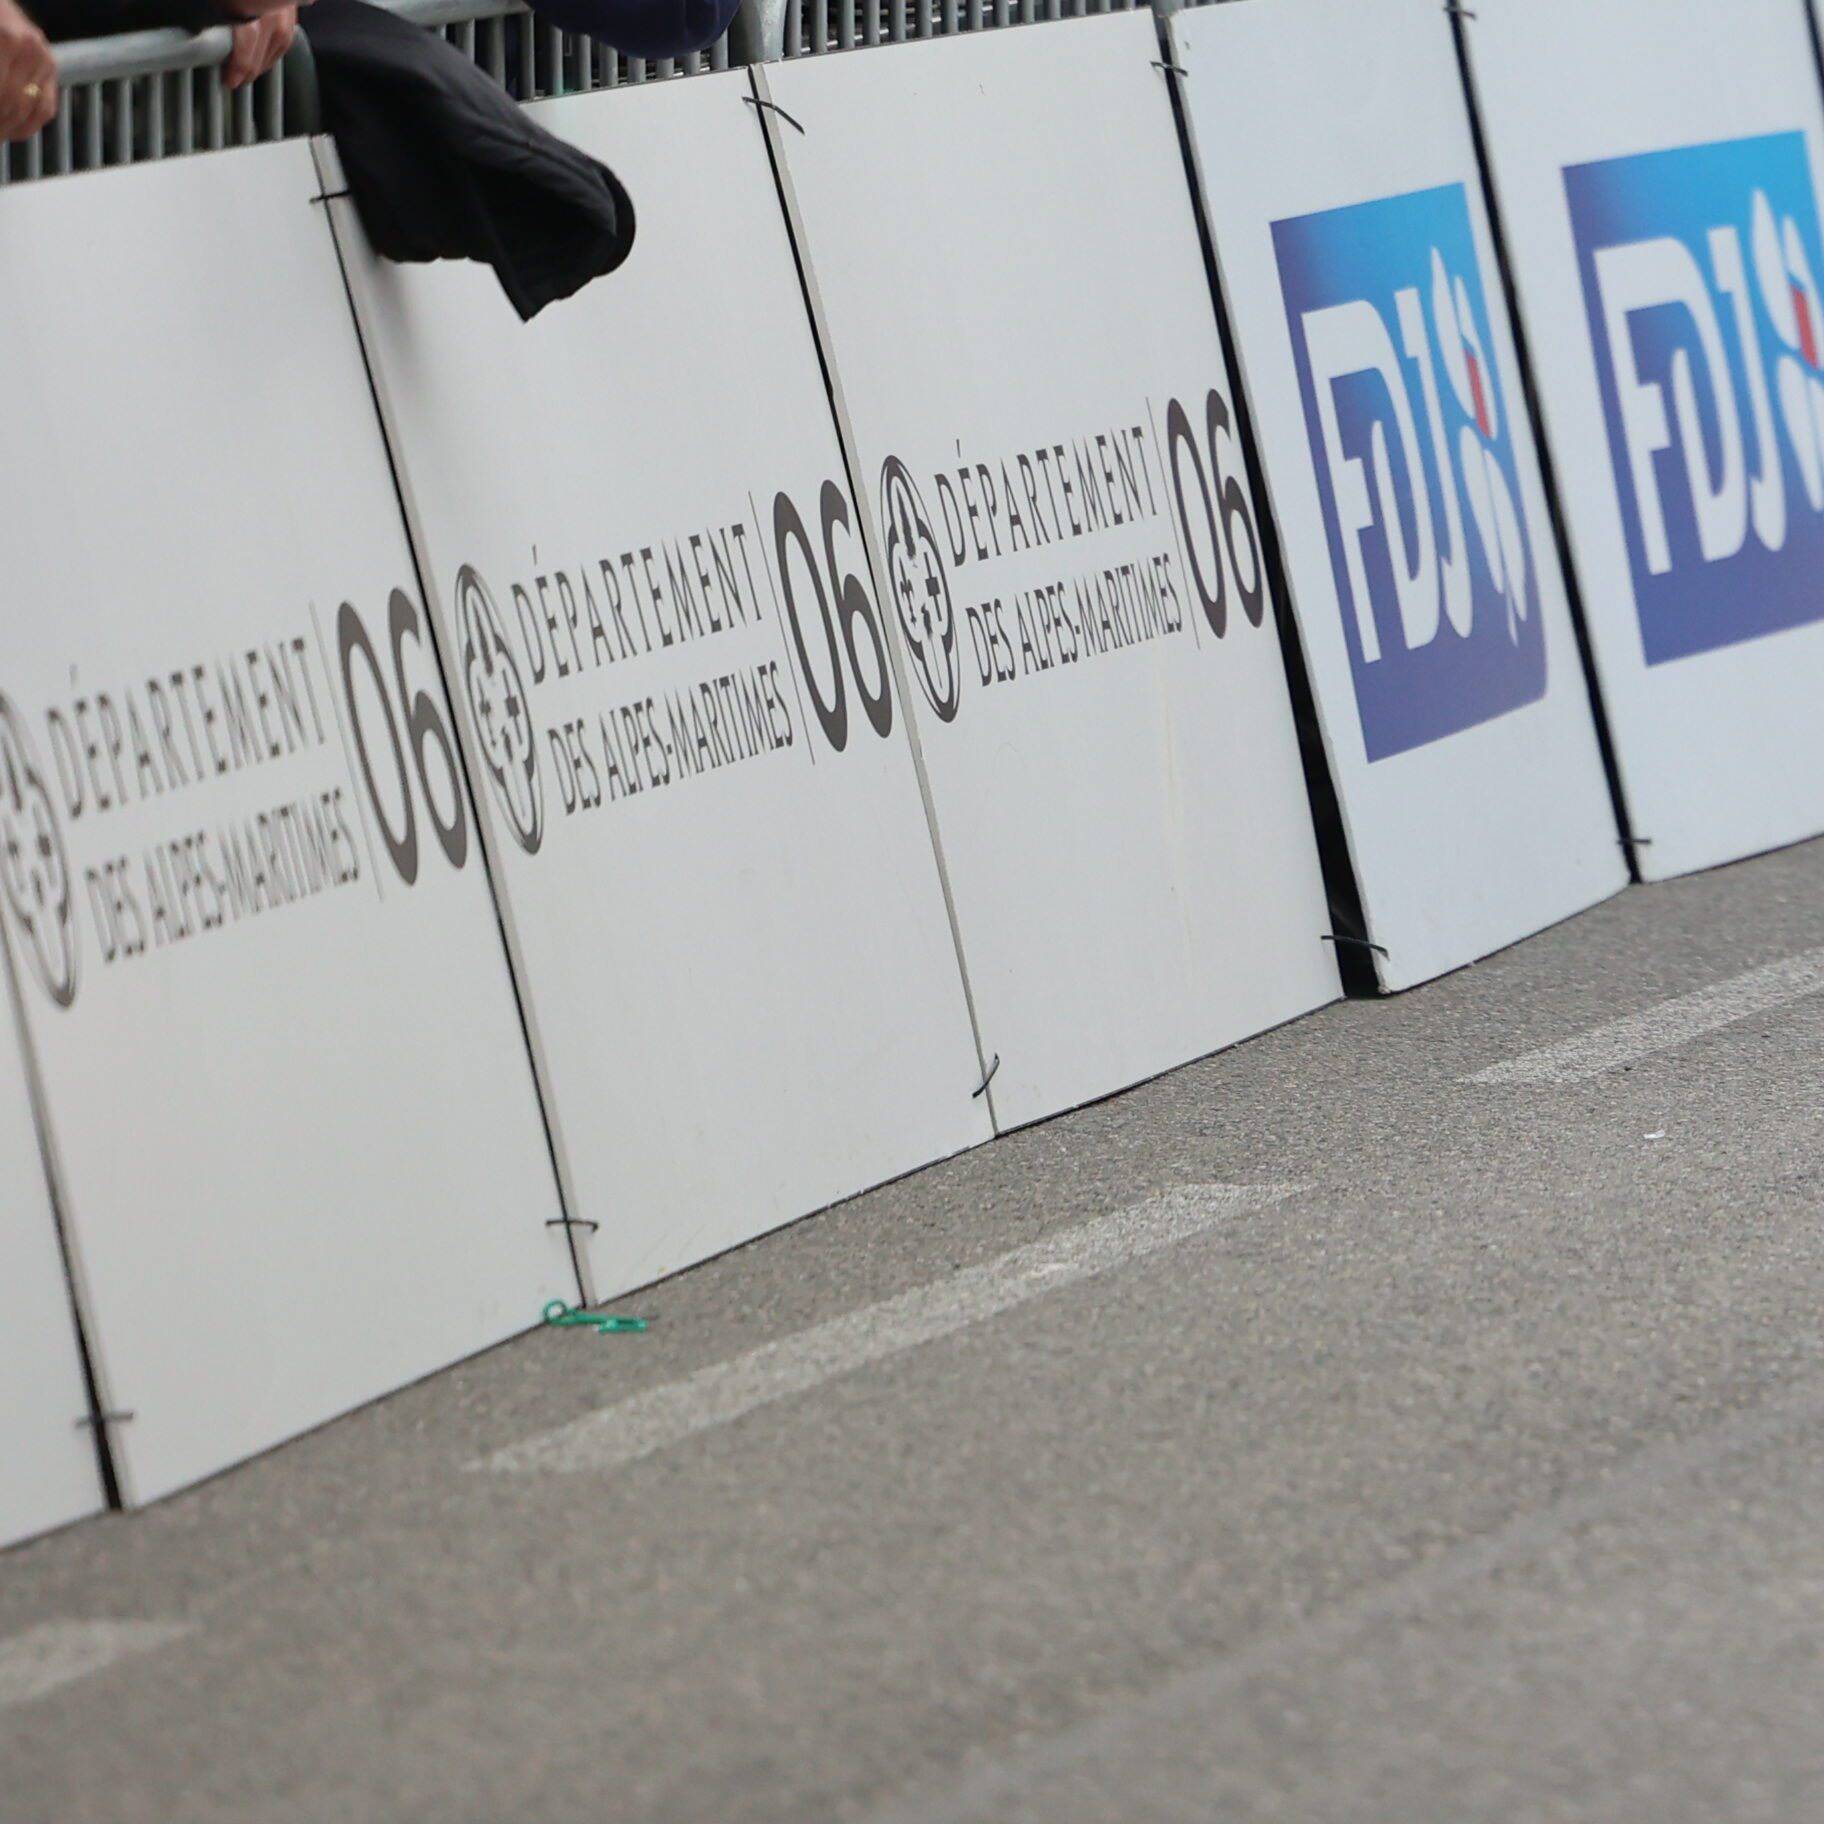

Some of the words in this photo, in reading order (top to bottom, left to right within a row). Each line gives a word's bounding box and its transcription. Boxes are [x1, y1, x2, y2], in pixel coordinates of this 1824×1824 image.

[511, 522, 763, 686] DÉPARTEMENT
[773, 479, 893, 753] 06
[936, 425, 1160, 568] DÉPARTEMENT
[1166, 388, 1265, 641] 06
[965, 598, 1019, 688] DES
[1019, 552, 1184, 672] ALPES-MARITIMES
[47, 637, 325, 820] DÉPARTEMENT
[338, 586, 468, 887] 06
[547, 717, 600, 816] DES
[604, 660, 795, 802] ALPES-MARITIMES
[86, 855, 145, 965] DES
[142, 786, 360, 948] ALPES-MARITIMES
